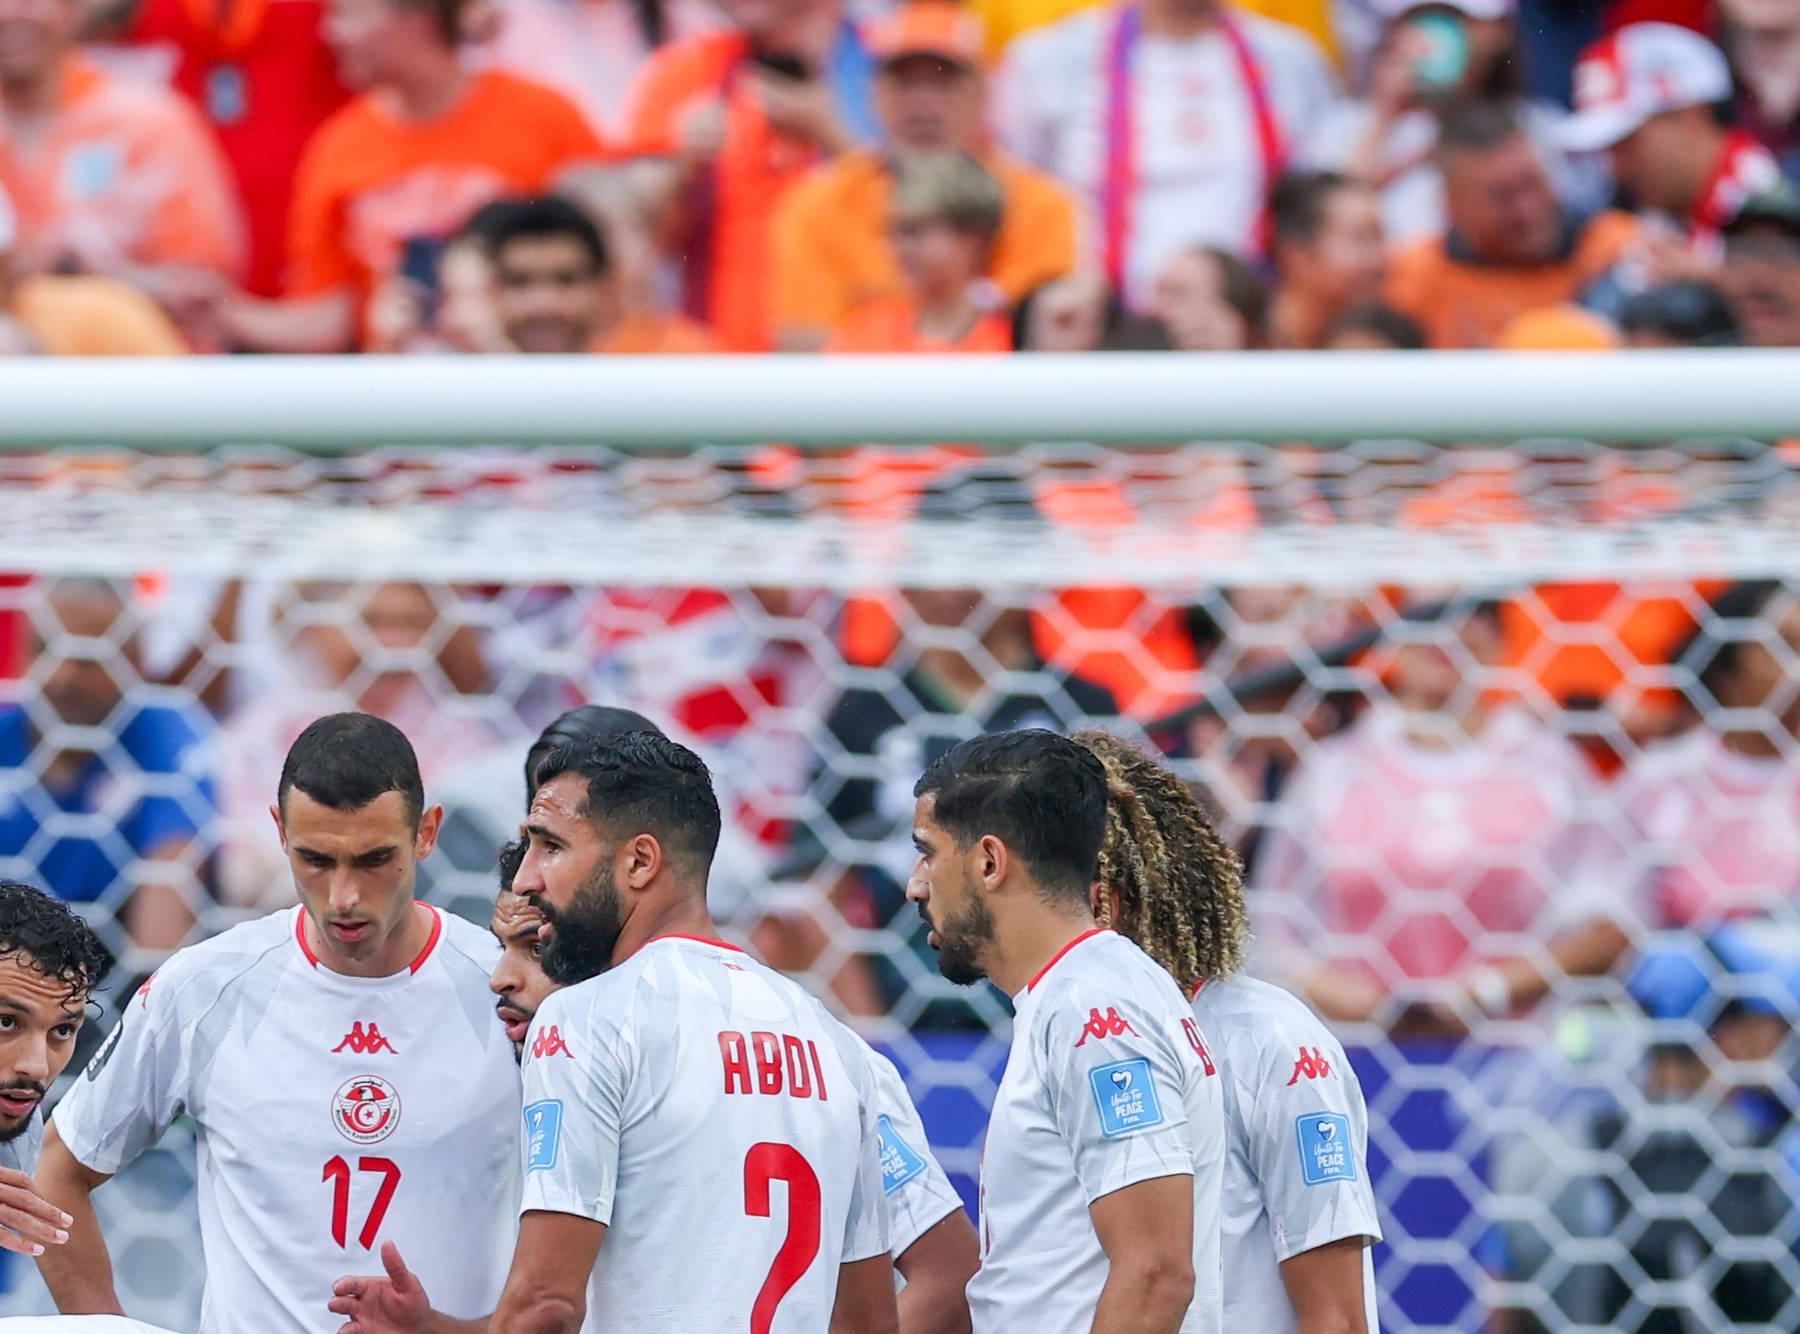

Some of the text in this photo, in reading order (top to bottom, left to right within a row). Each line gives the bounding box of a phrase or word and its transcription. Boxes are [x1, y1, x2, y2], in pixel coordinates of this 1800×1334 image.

[717, 1030, 828, 1101] ABDI
[1114, 1101, 1145, 1119] PEACE
[1317, 1153, 1345, 1168] PEACE
[322, 1154, 402, 1251] 17
